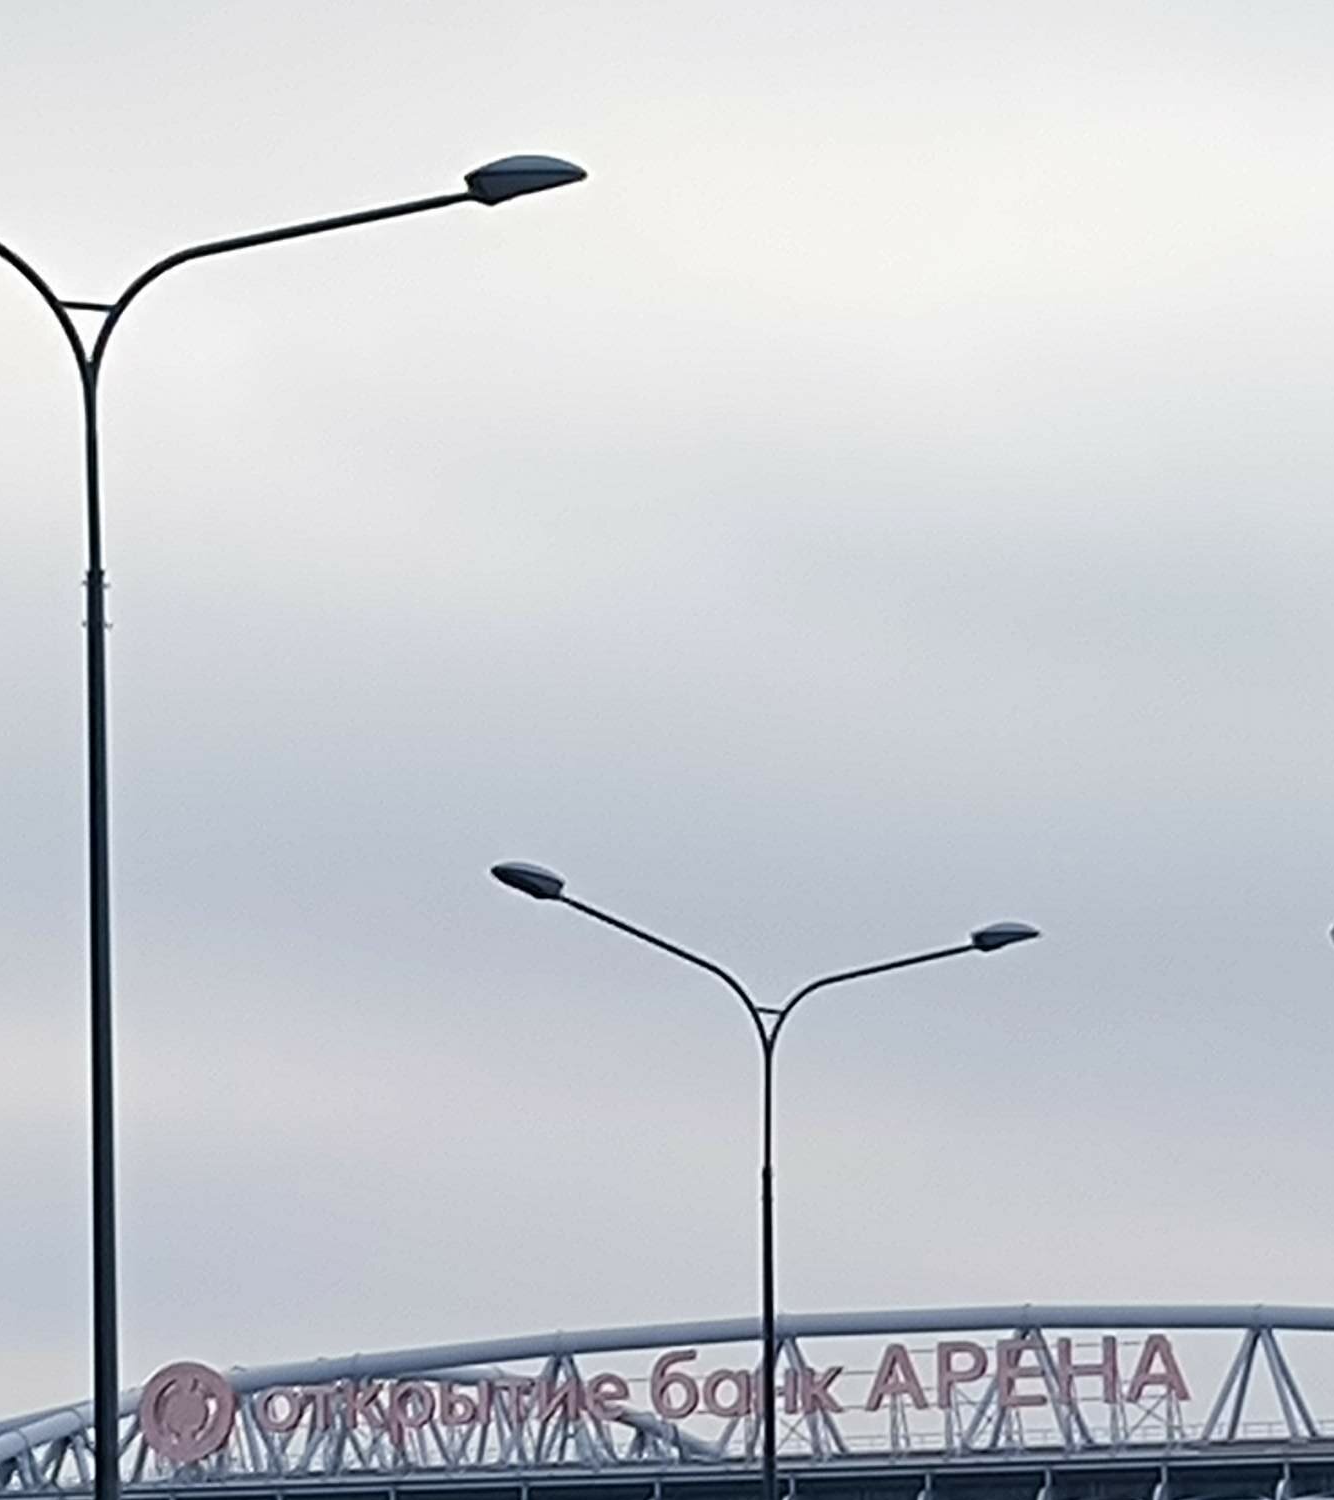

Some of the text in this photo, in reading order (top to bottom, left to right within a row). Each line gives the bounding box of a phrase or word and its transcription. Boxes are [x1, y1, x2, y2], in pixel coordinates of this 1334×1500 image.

[256, 1334, 1191, 1450] открытие банк АРЕНА
